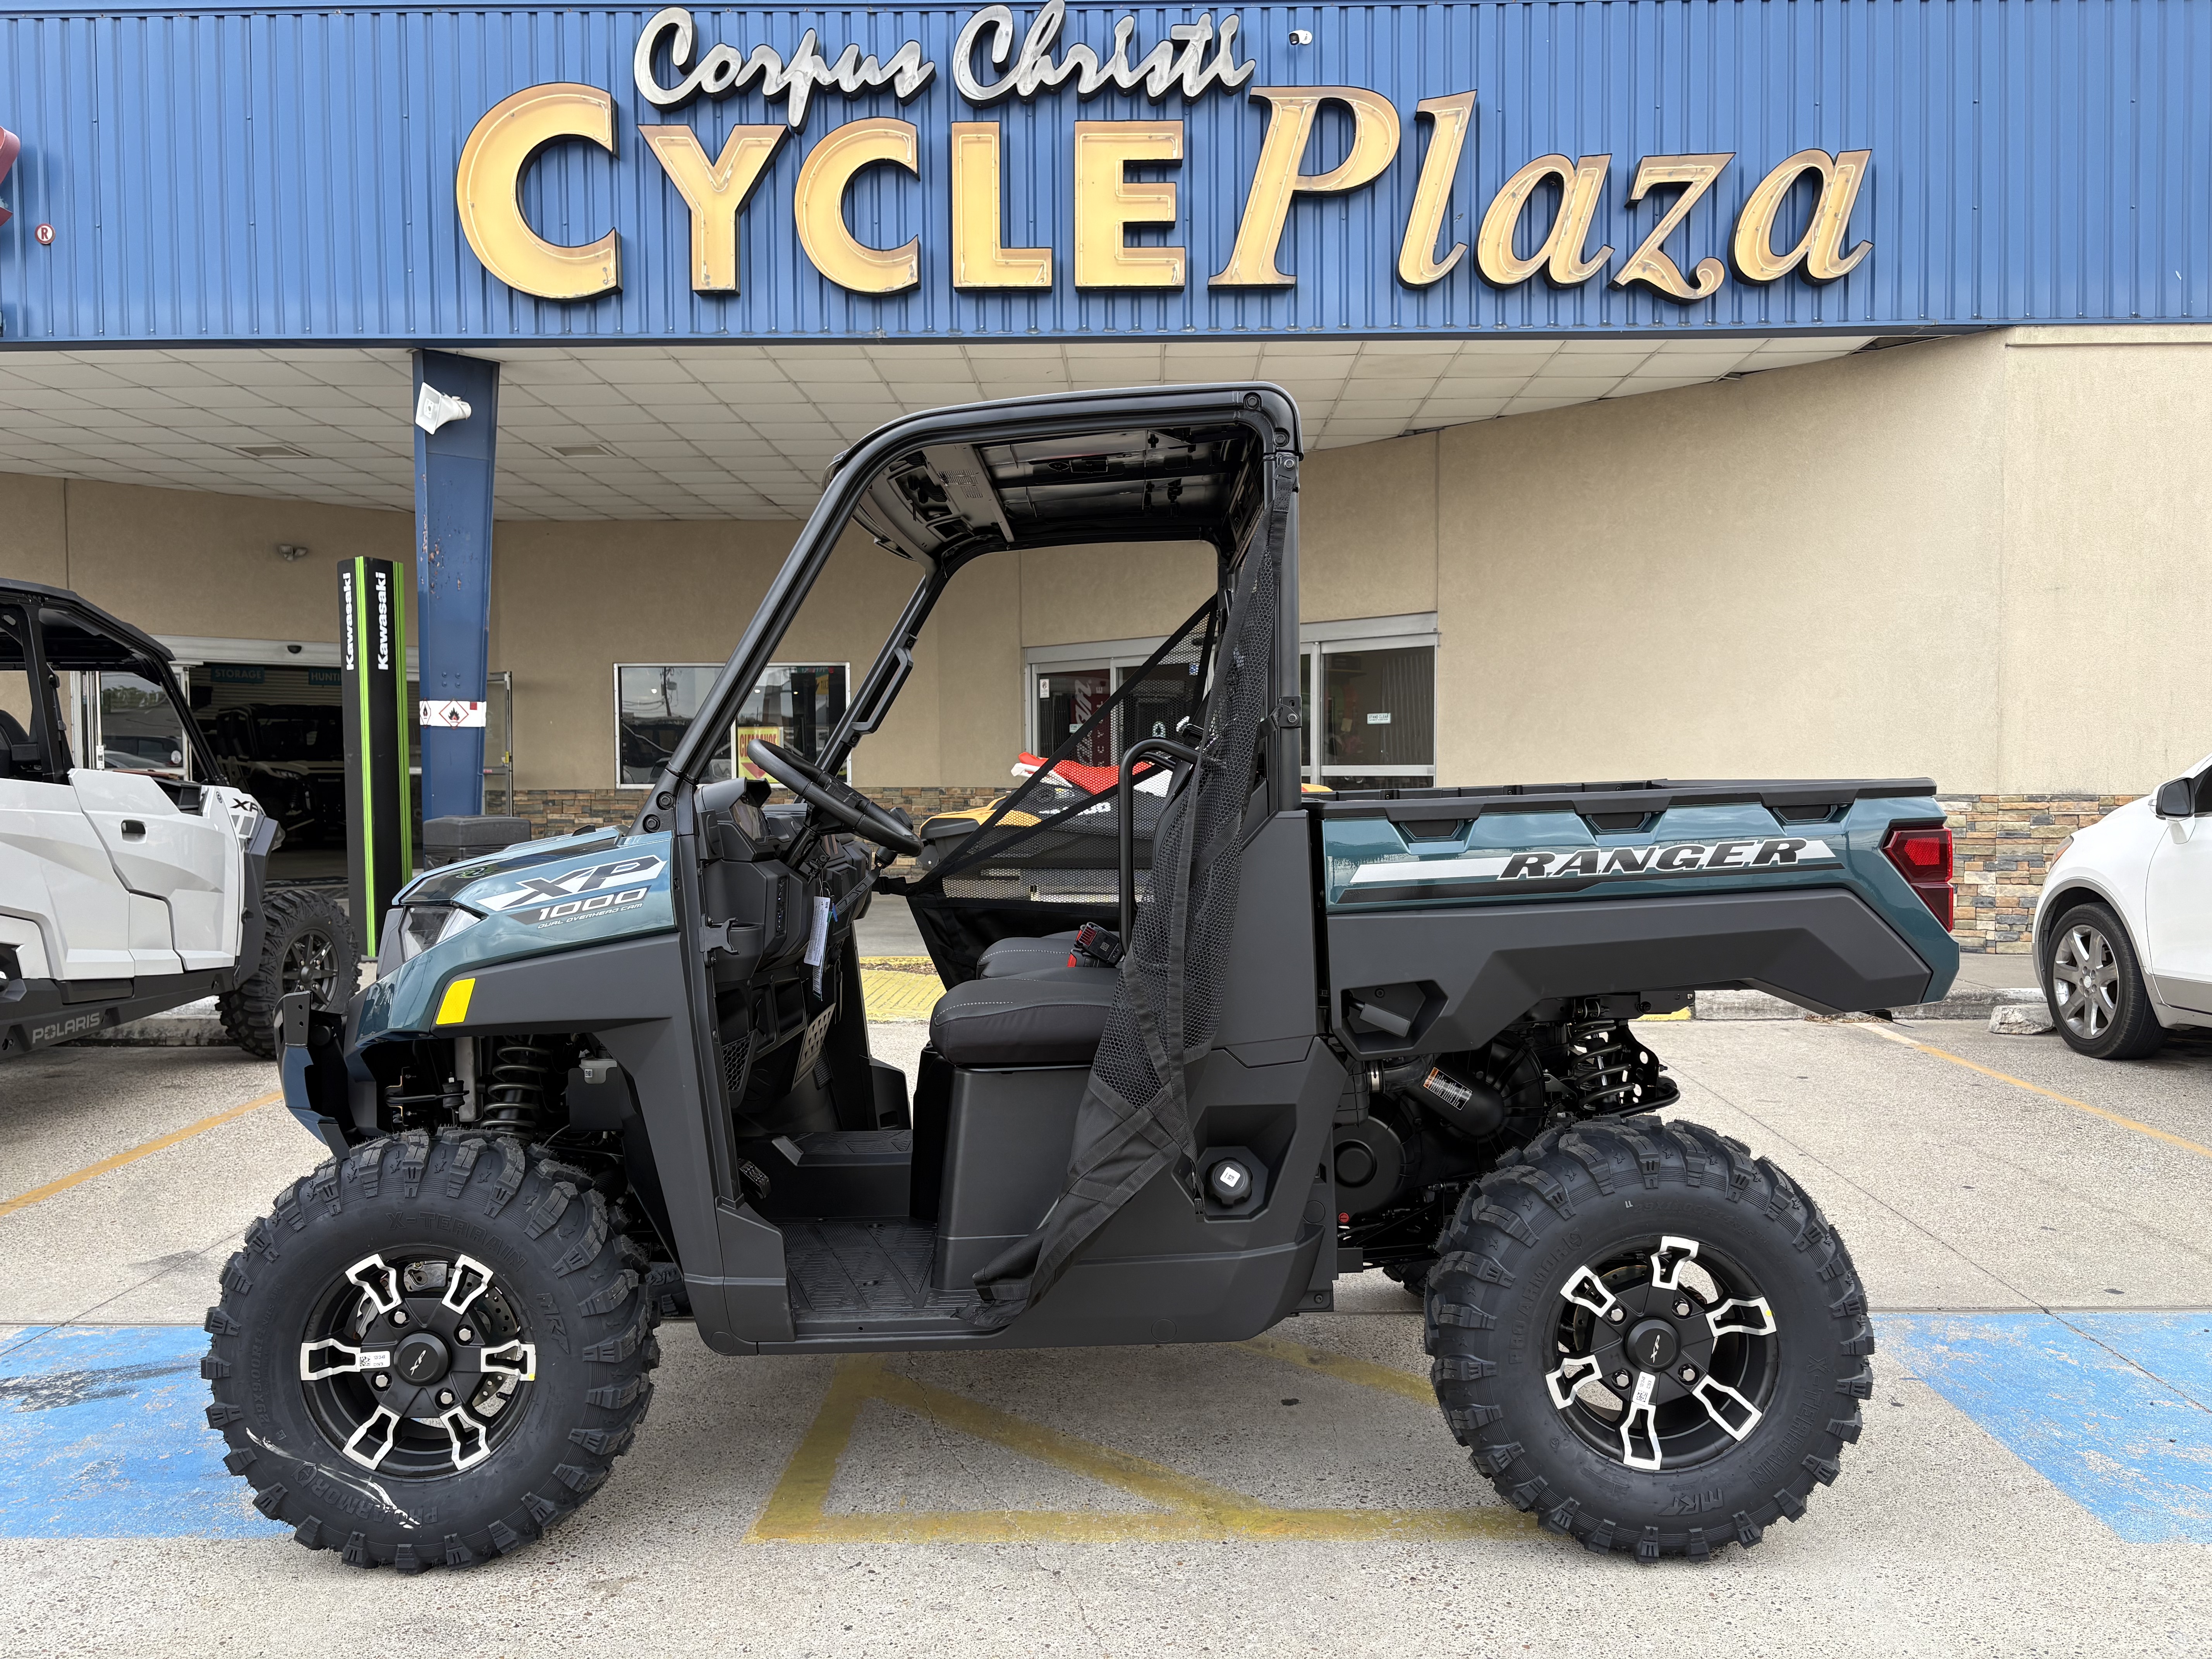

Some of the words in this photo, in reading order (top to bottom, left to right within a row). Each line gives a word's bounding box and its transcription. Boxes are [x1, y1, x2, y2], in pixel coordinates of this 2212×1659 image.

[634, 7, 935, 133] Corpus
[953, 0, 1255, 106] Christi
[456, 82, 1185, 302] CYCLE
[1207, 85, 1874, 305] Plaza
[343, 572, 354, 670] Kawasaki
[376, 572, 388, 670] Kawasaki
[215, 669, 262, 679] STORAGE
[311, 672, 340, 681] HUNTI
[500, 855, 661, 910] XP
[1496, 837, 1808, 880] RANGER
[538, 887, 647, 921] 1000
[538, 920, 563, 929] DUAL
[566, 908, 619, 923] OVERHEAD
[620, 903, 643, 911] CAM
[32, 1012, 100, 1043] POLARIS
[385, 1211, 527, 1272] X-TERRAIN
[1509, 1319, 1525, 1364] PRO
[1517, 1245, 1569, 1317] ARMOR
[409, 1350, 426, 1376] XP
[1650, 1334, 1661, 1364] XP
[251, 1326, 270, 1424] 29X9.00R14
[1748, 1354, 1828, 1489] X-TERRAIN
[311, 1477, 388, 1522] ARMOR
